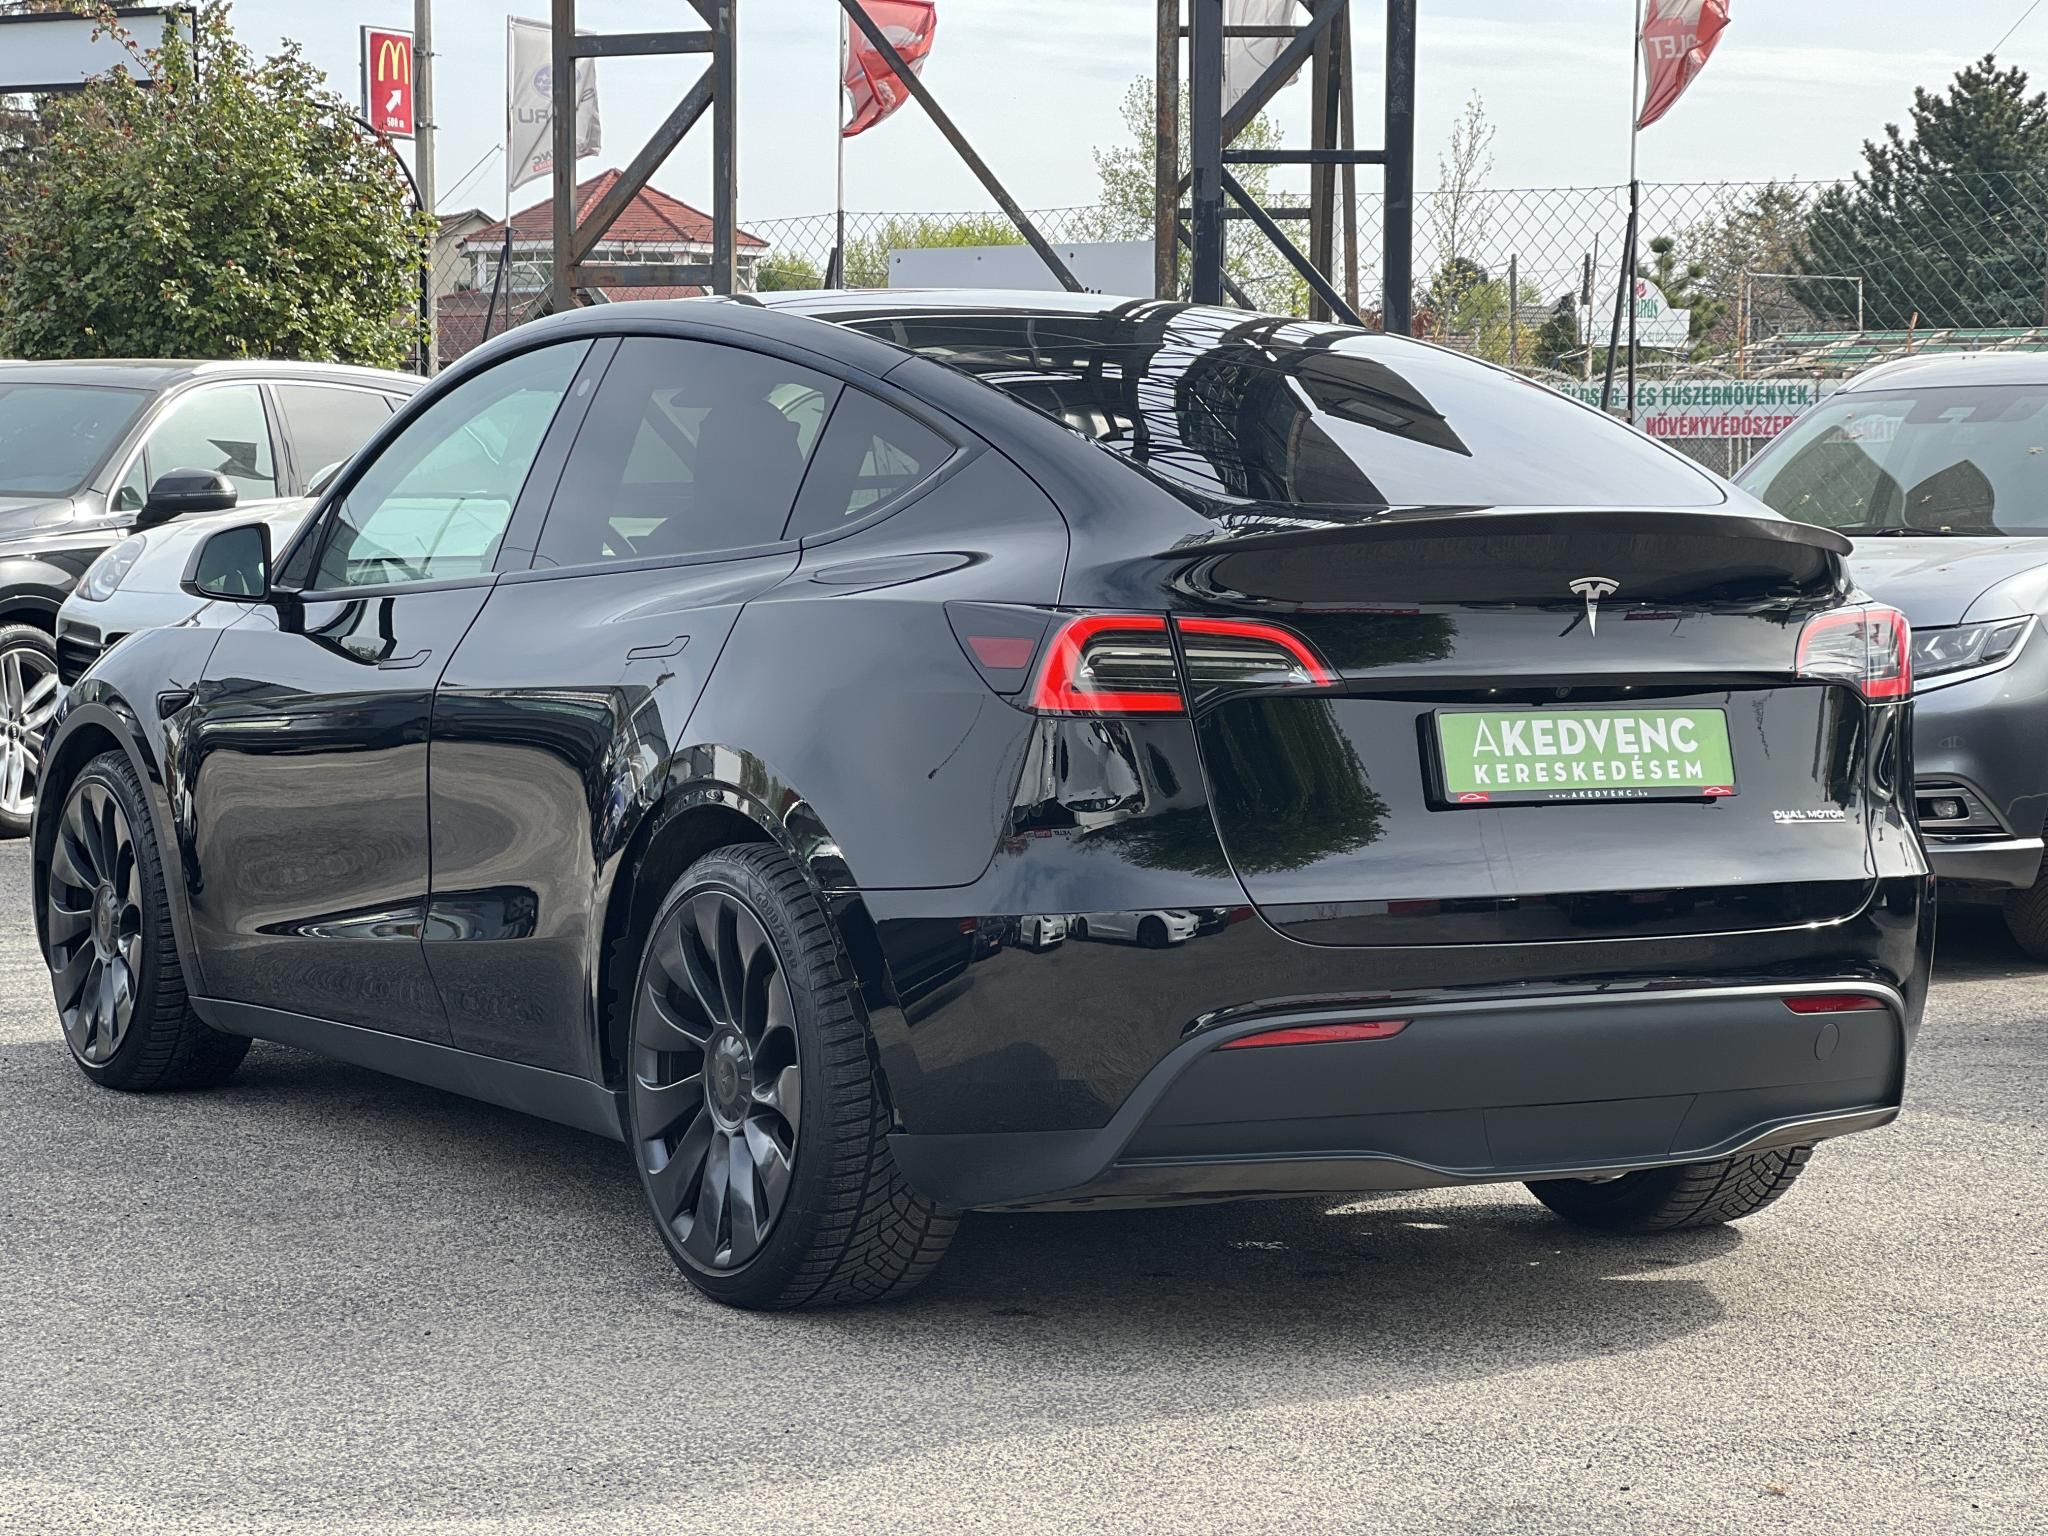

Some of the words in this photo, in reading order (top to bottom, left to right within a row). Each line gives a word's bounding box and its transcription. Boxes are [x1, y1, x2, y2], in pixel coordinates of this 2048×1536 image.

[1637, 382, 1657, 406] ÉS
[1646, 409, 1801, 436] NÖVÉNYVÉDŐSZER
[1473, 755, 1704, 784] KERESKEDÉSEM
[1773, 810, 1805, 819] DUAL
[1807, 810, 1845, 819] MOTOR
[755, 892, 798, 969] GOODYEAR
